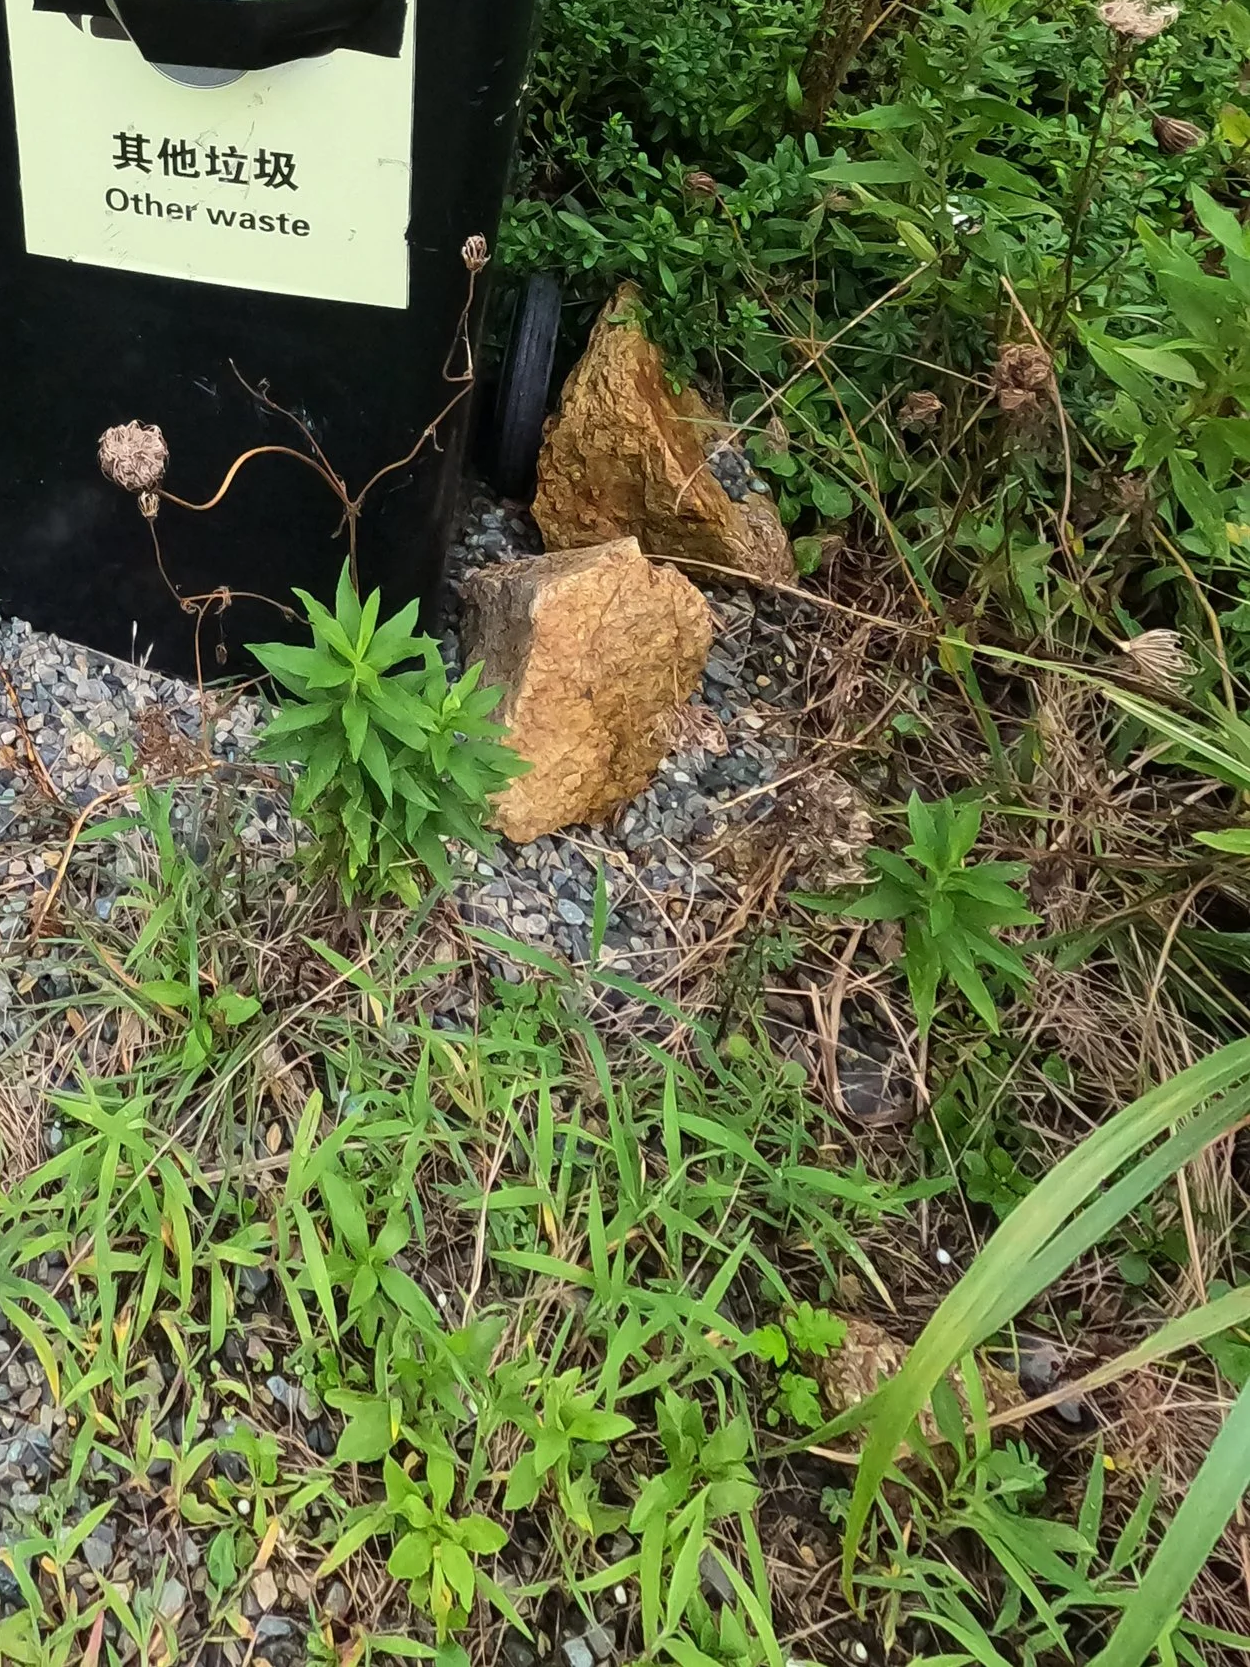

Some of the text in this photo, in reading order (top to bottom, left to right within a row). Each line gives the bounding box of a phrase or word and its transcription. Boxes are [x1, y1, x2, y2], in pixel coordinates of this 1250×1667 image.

[112, 131, 299, 192] 其他垃圾
[105, 187, 311, 237] Other waste
